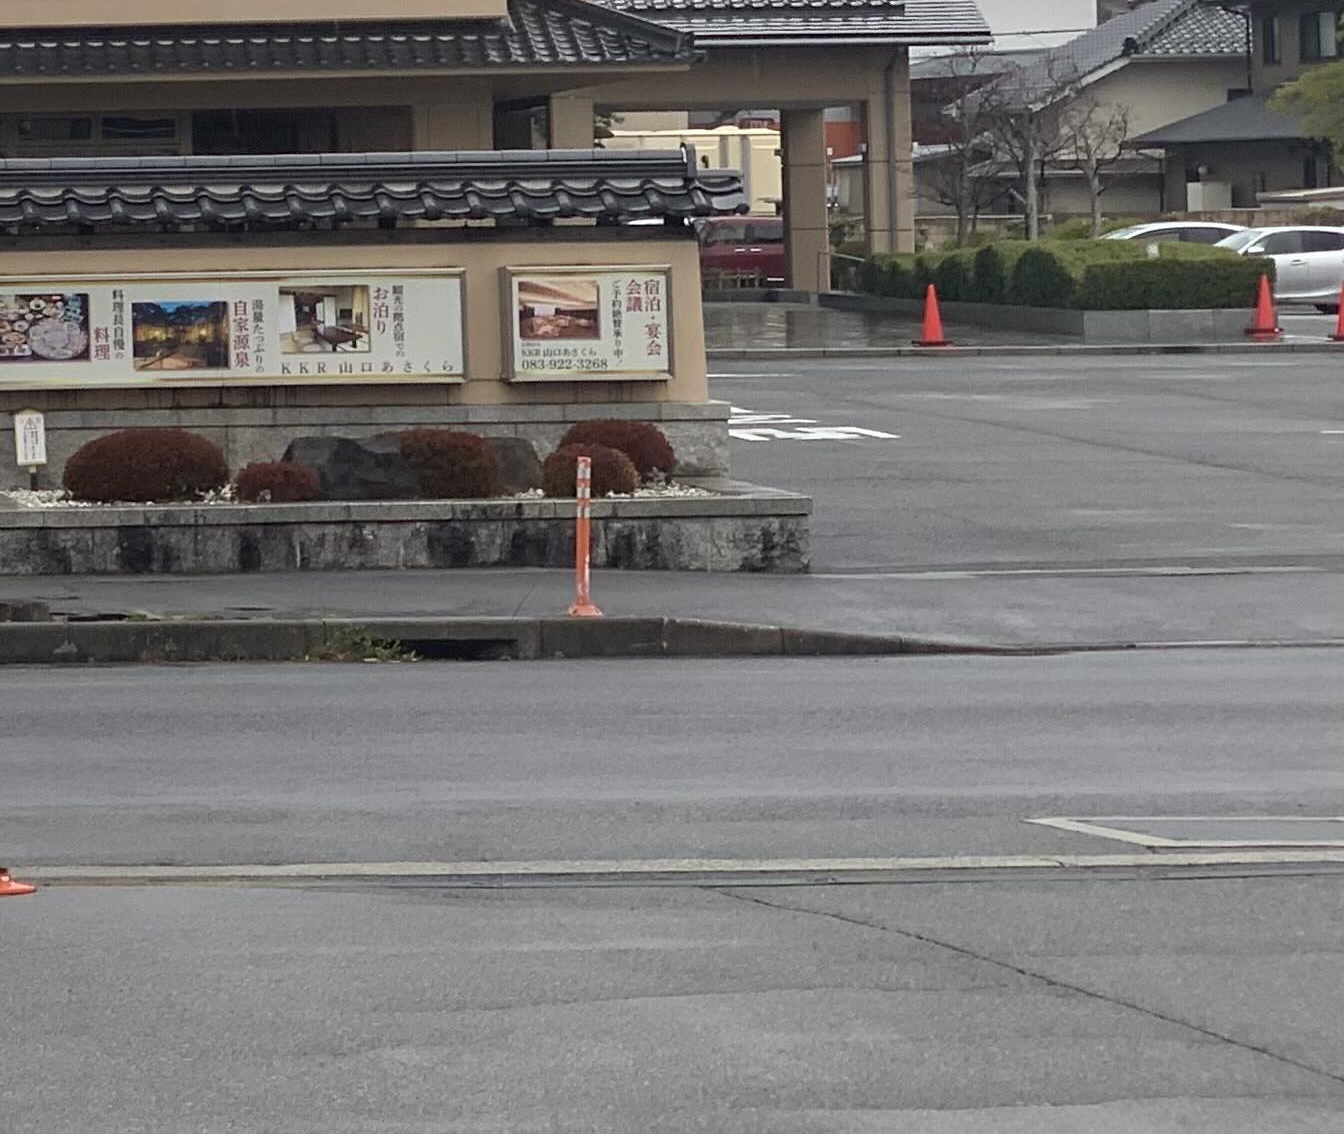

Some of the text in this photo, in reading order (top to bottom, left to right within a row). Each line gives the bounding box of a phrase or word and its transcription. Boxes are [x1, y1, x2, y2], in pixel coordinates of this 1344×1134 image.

[373, 286, 389, 335] お泊り
[625, 279, 643, 313] 会議
[112, 289, 125, 360] 料理長自慢の
[232, 300, 251, 368] 自家源泉
[93, 326, 111, 362] 料理
[281, 361, 327, 375] KKR
[521, 358, 609, 371] 083-922-3268
